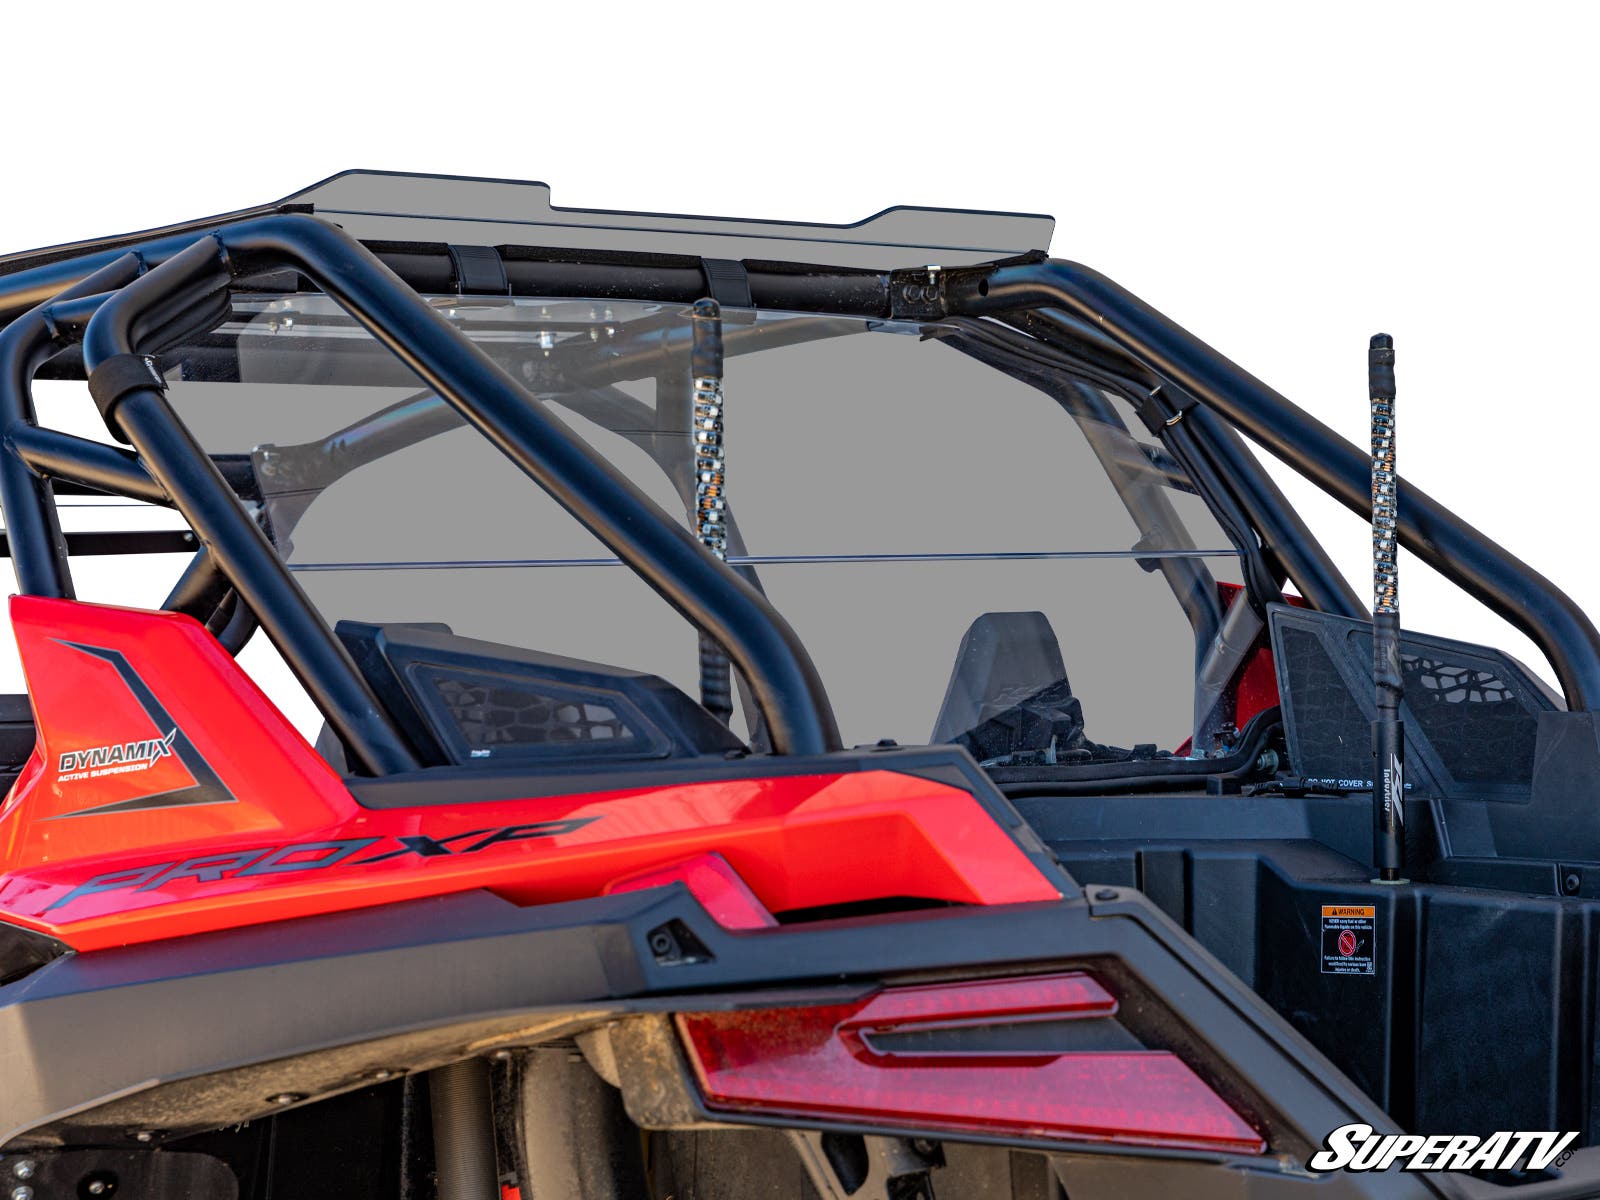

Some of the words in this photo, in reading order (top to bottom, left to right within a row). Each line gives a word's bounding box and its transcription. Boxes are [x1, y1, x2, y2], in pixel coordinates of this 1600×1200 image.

[58, 727, 177, 773] DYNAMIX
[58, 772, 89, 782] ACTIVE
[90, 763, 148, 778] SUSPENSION
[1338, 779, 1363, 788] COVER
[1383, 768, 1391, 812] Industries
[43, 837, 384, 912] PRO
[1338, 908, 1365, 916] WARNING
